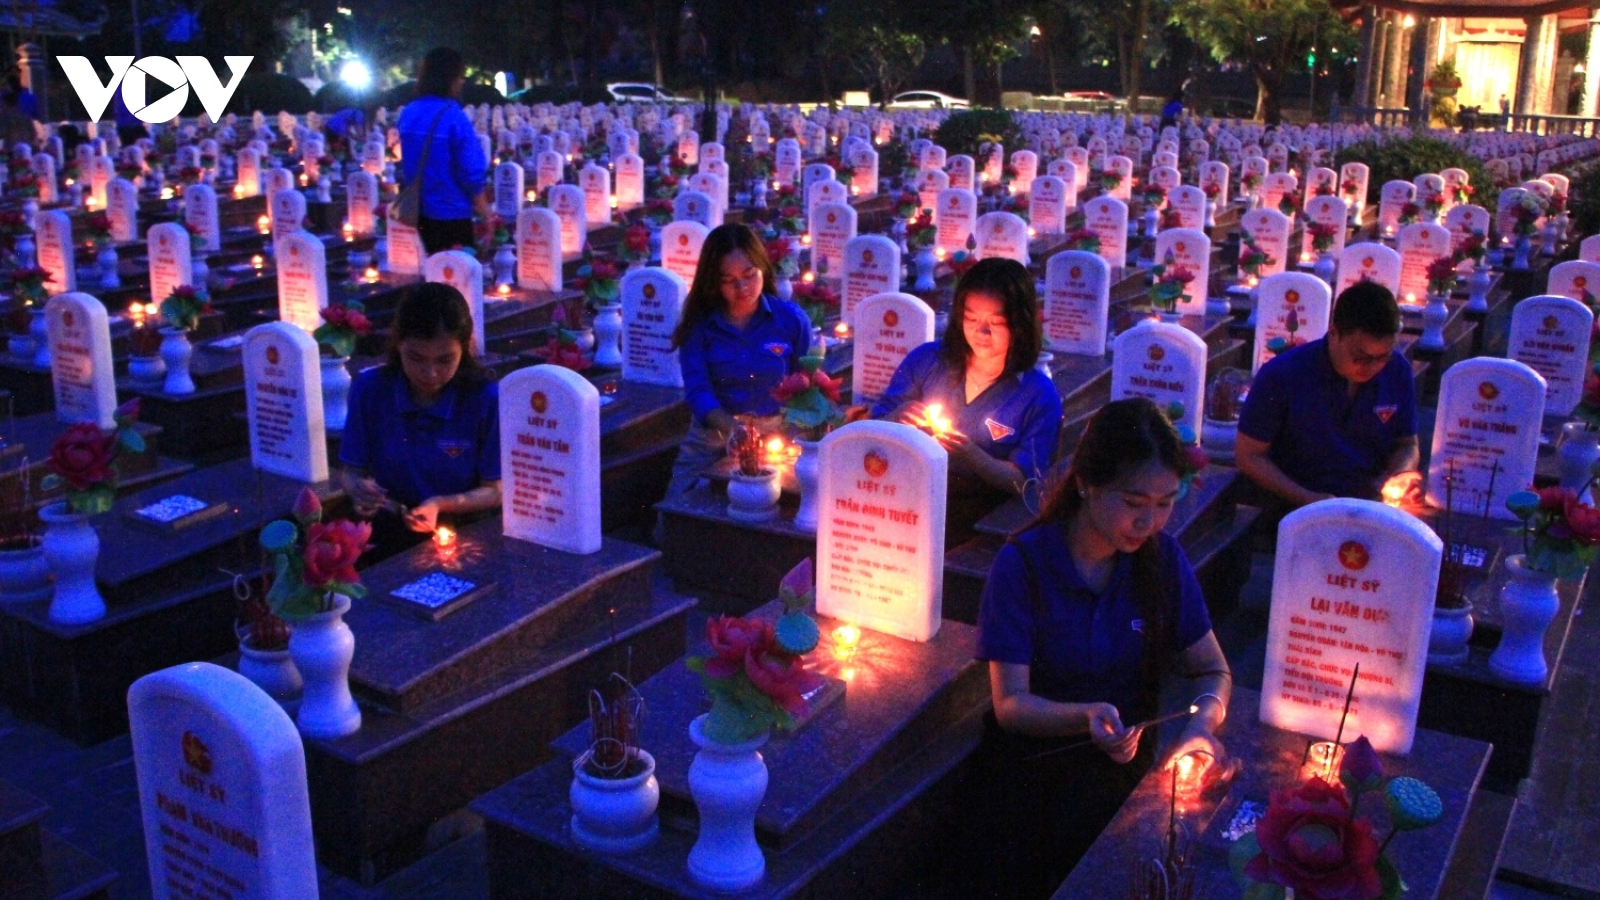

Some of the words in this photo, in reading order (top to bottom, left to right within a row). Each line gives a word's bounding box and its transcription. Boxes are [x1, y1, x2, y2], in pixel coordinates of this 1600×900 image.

[857, 480, 879, 494] LIỆT
[1327, 573, 1358, 589] LIỆT
[1362, 579, 1380, 593] SỸ
[1311, 597, 1330, 615] LẠI
[1334, 600, 1359, 618] VĂN
